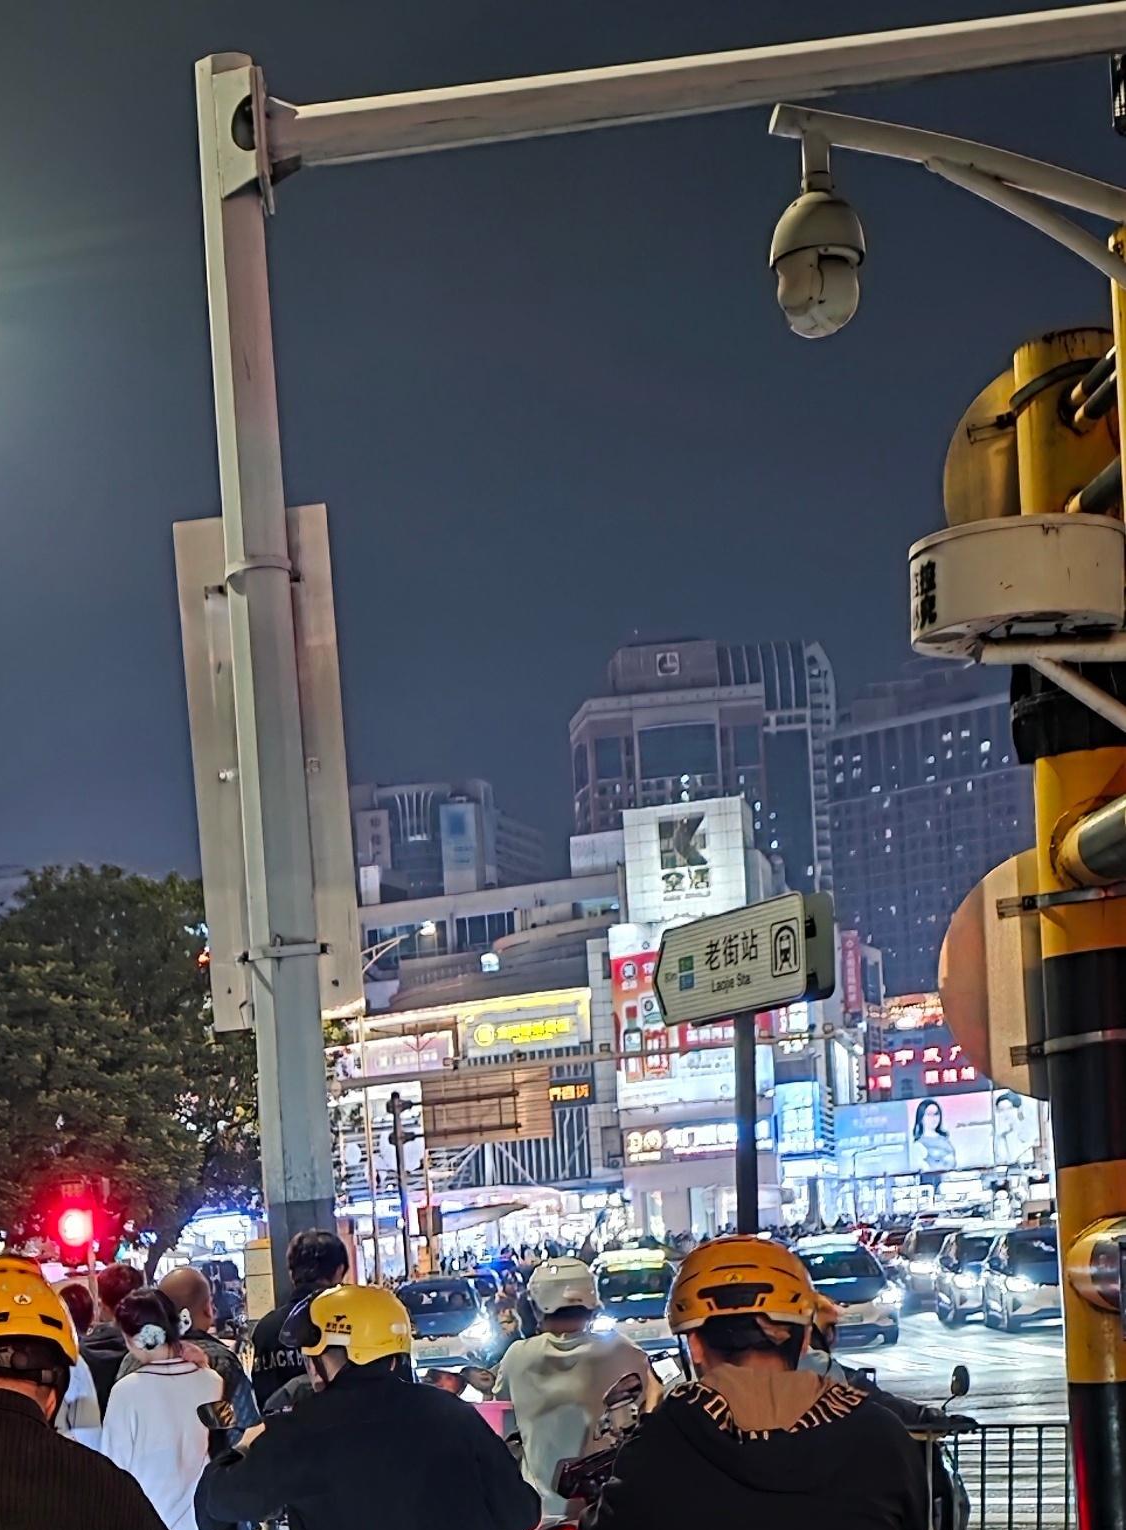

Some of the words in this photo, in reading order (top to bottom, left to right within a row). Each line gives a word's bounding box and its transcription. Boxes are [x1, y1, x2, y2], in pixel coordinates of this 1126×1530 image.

[705, 929, 759, 971] 老街站
[711, 977, 735, 994] Laojie
